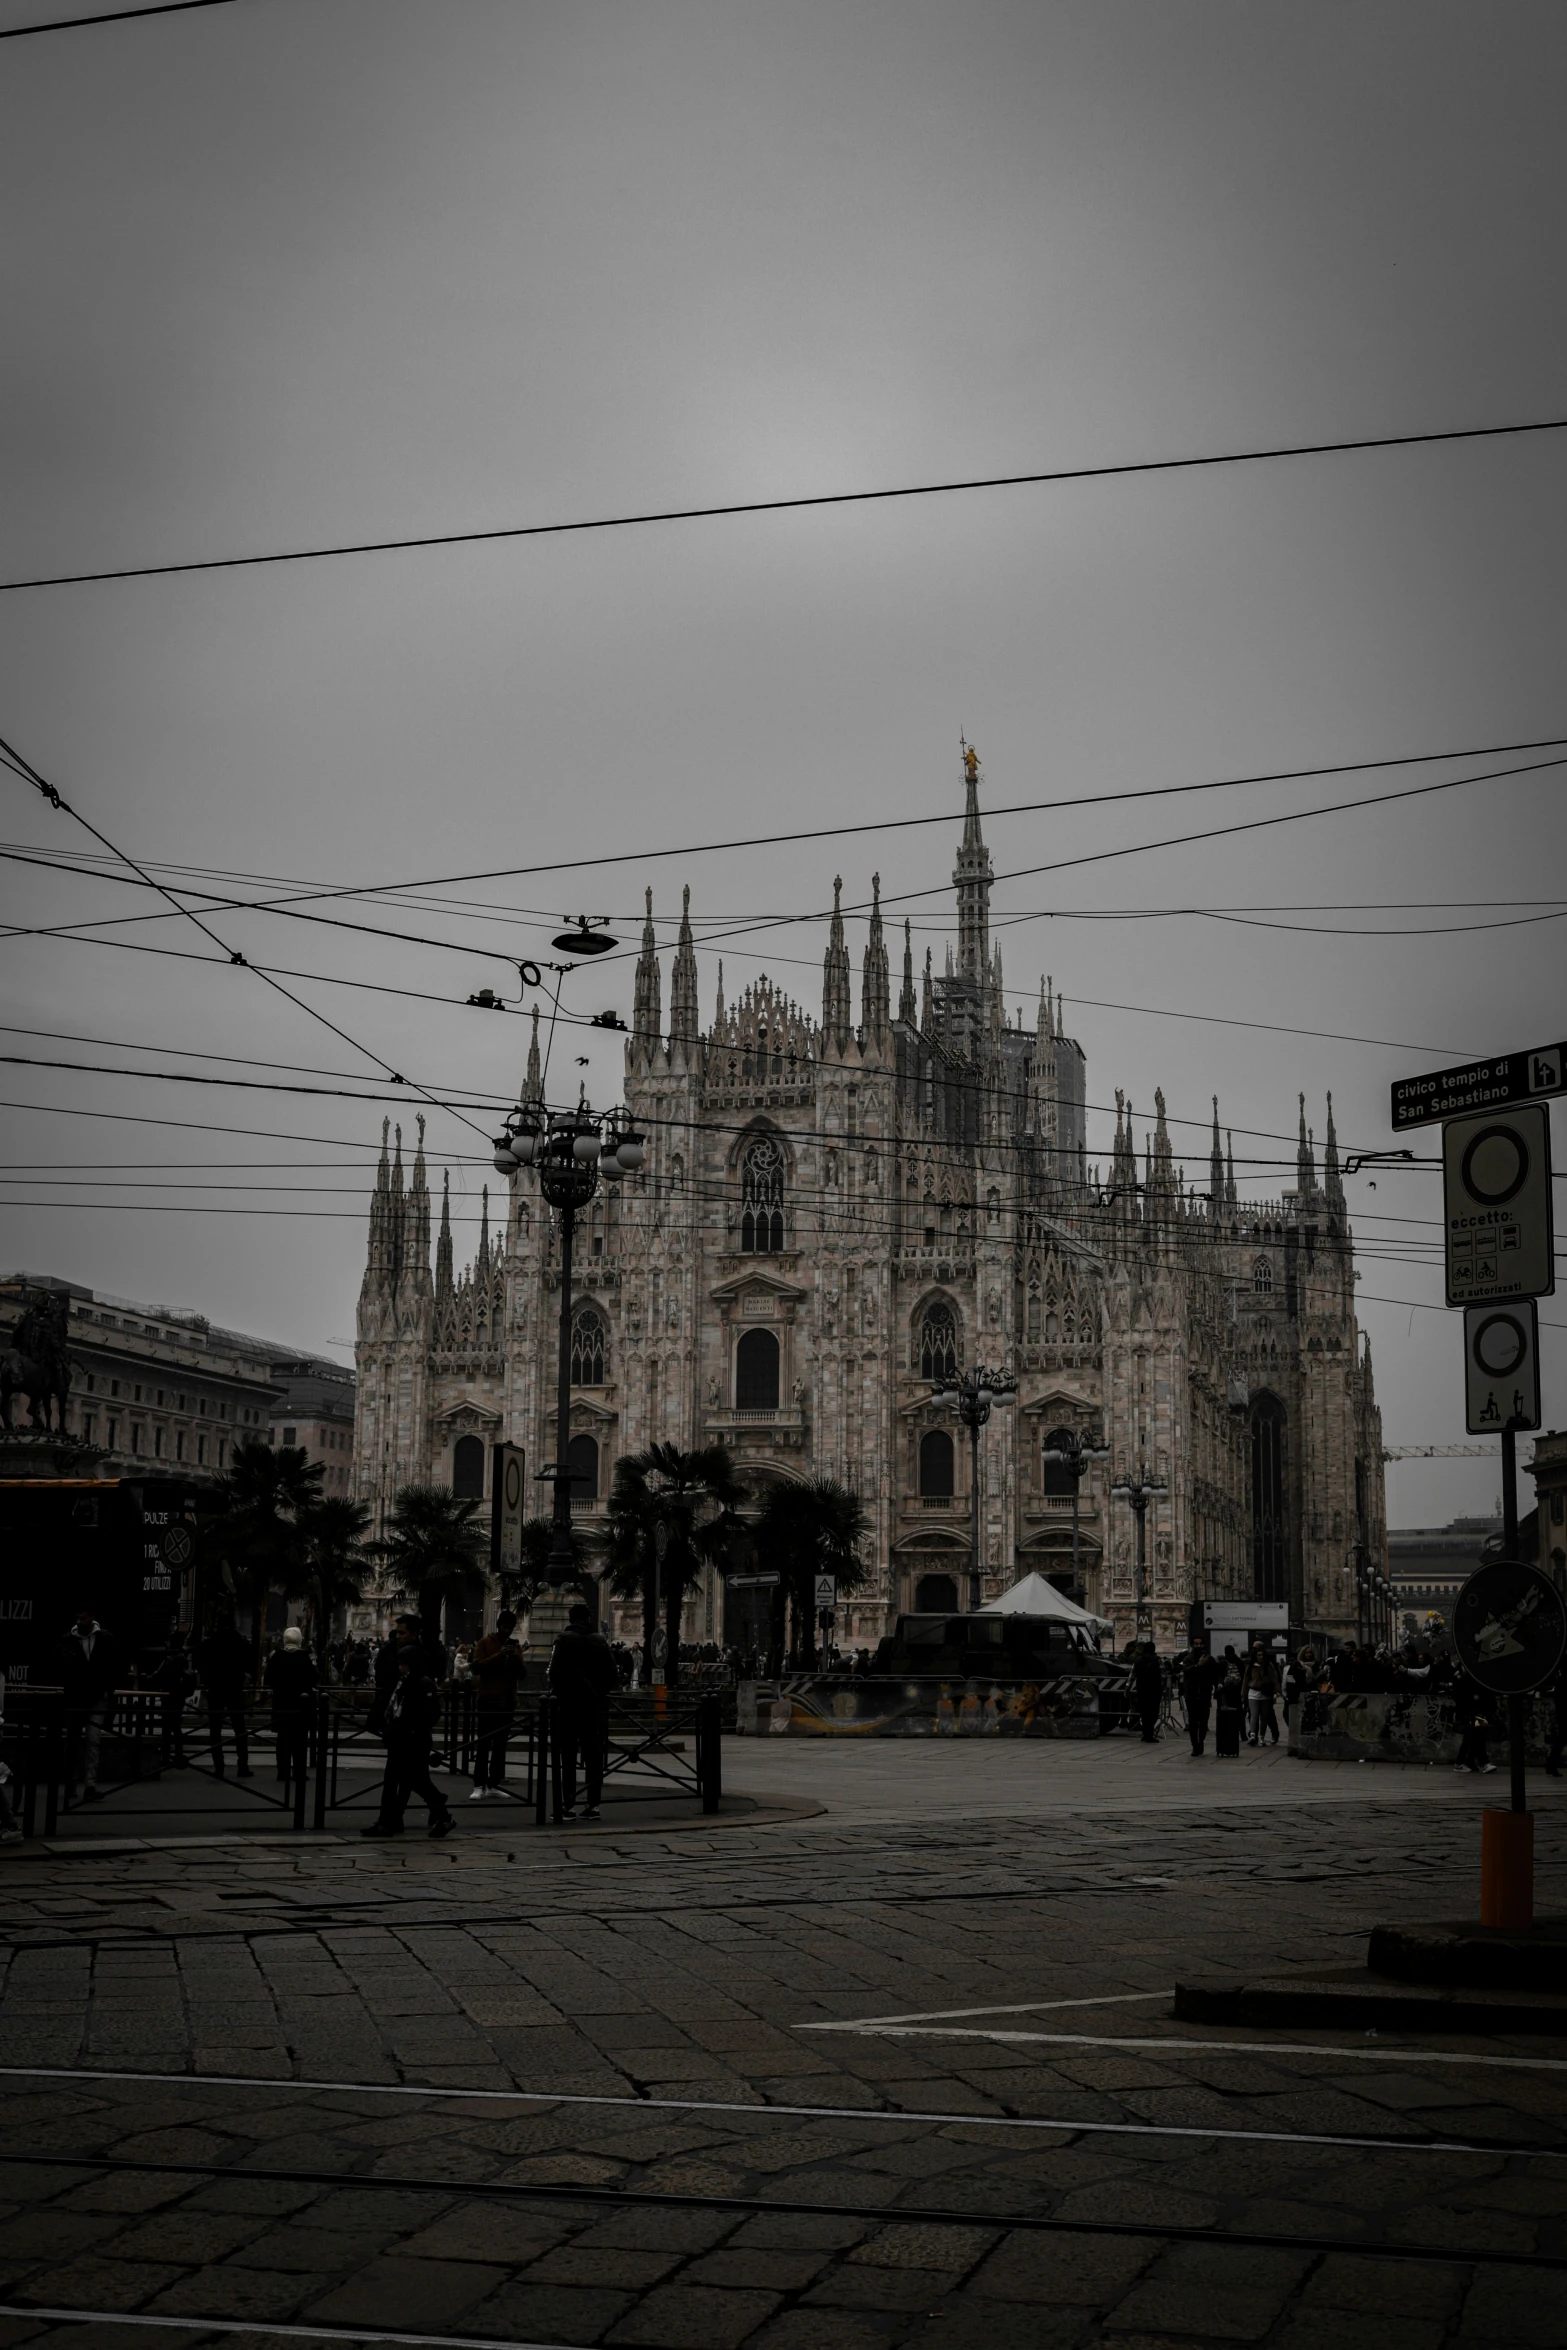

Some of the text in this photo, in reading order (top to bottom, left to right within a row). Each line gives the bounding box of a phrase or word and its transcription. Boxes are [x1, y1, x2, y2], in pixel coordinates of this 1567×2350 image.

[1397, 1060, 1509, 1100] civico tempio di
[1398, 1085, 1510, 1120] San Sebastiano
[1451, 1210, 1513, 1229] eccetto:
[1452, 1282, 1522, 1299] ed autorizzati
[144, 1511, 169, 1525] PULZE
[143, 1576, 172, 1591] 20 UTILIZZI
[8, 1665, 30, 1681] NOT
